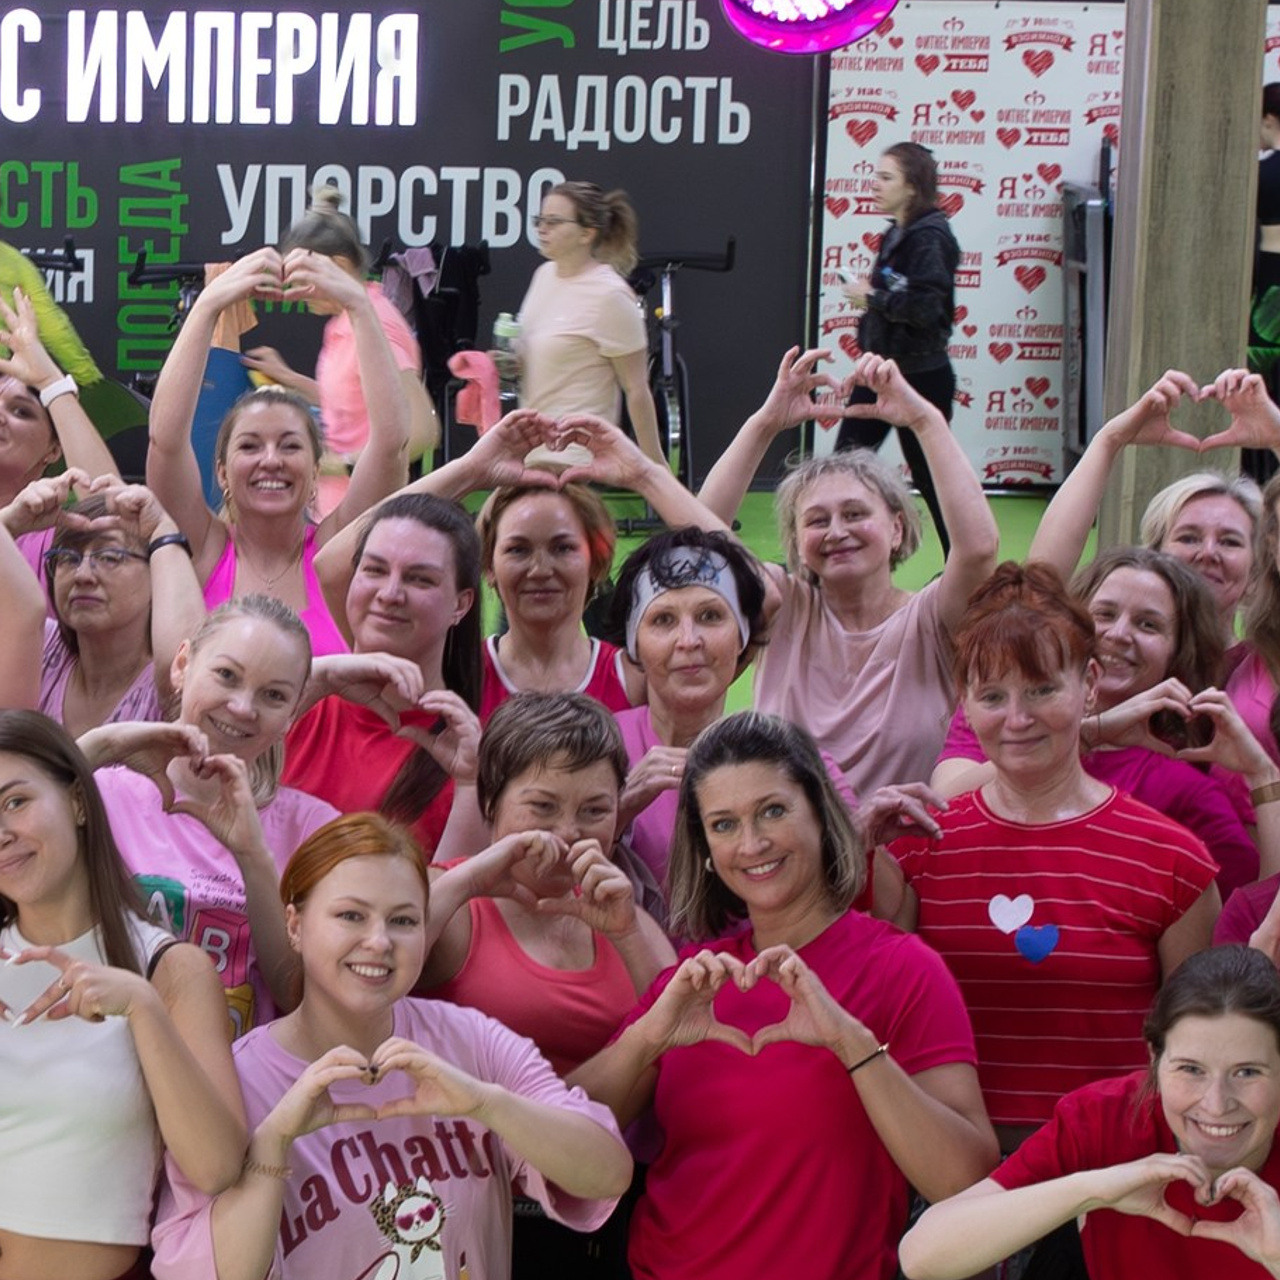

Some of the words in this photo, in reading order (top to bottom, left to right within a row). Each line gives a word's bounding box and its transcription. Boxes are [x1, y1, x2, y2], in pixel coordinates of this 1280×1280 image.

[1088, 34, 1107, 56] Я
[66, 10, 419, 126] ИМПЕРИЯ
[497, 74, 751, 150] РАДОСТЬ
[911, 104, 931, 126] Я
[998, 177, 1017, 199] Я
[824, 246, 842, 268] Я
[986, 390, 1006, 413] Я
[201, 927, 231, 972] B
